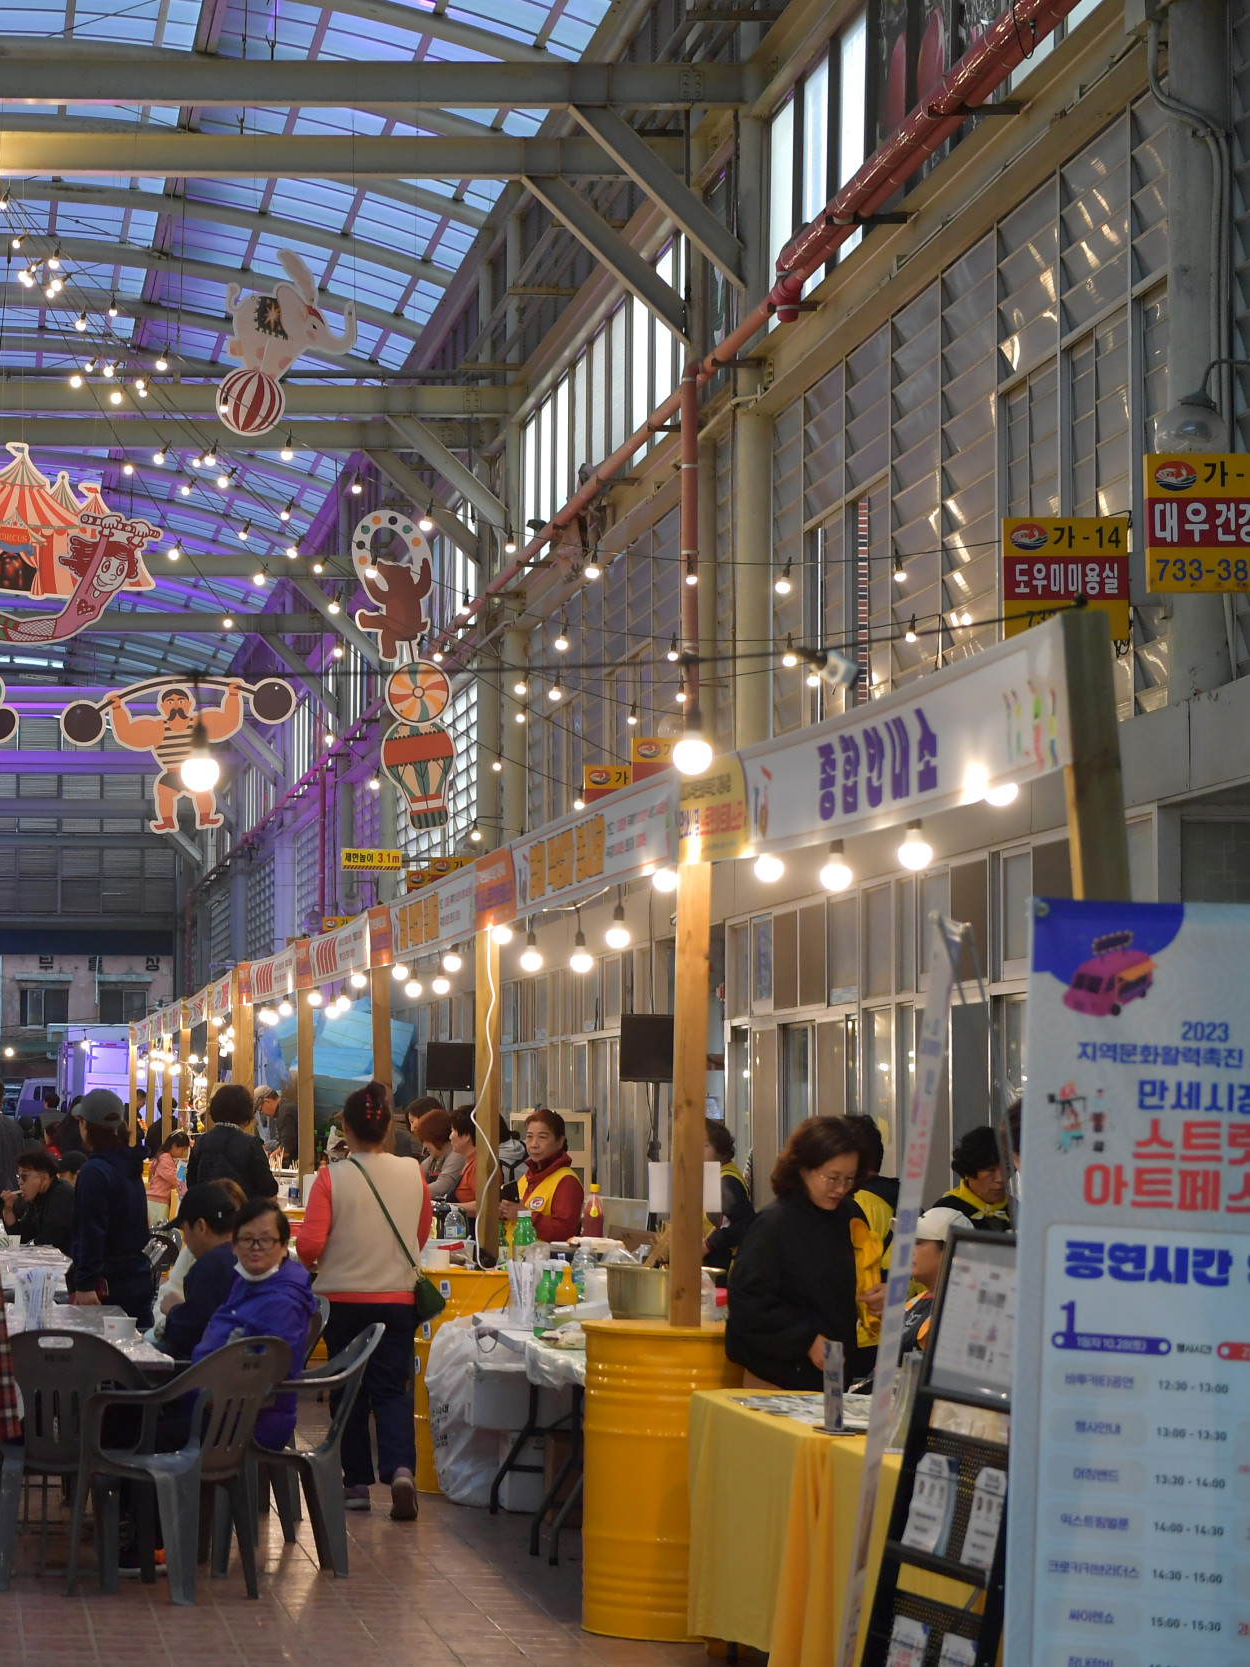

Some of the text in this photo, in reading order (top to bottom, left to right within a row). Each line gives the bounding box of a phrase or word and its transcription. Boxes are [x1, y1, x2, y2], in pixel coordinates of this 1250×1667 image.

[0, 533, 28, 543] CIRCUS
[1015, 563, 1119, 596] 도우미미용실
[816, 707, 939, 822] 종합안내소
[345, 852, 374, 864] 제한높이
[1181, 1021, 1229, 1042] 2023
[1077, 1042, 1243, 1069] 지역문화활력촉진
[1064, 1240, 1233, 1287] 공연시간
[1158, 1379, 1188, 1392] 12:30
[1199, 1381, 1229, 1395] 13:00
[1156, 1427, 1186, 1440] 13:00
[1197, 1429, 1227, 1442] 13:30
[1154, 1474, 1184, 1486] 13:30
[1196, 1476, 1226, 1489] 14:00
[1153, 1521, 1183, 1534] 14:00
[1194, 1523, 1224, 1537] 14:30
[1152, 1568, 1182, 1581] 14:30
[1193, 1571, 1223, 1584] 15:00
[1150, 1616, 1181, 1629] 15:00
[1191, 1619, 1222, 1632] 15:30
